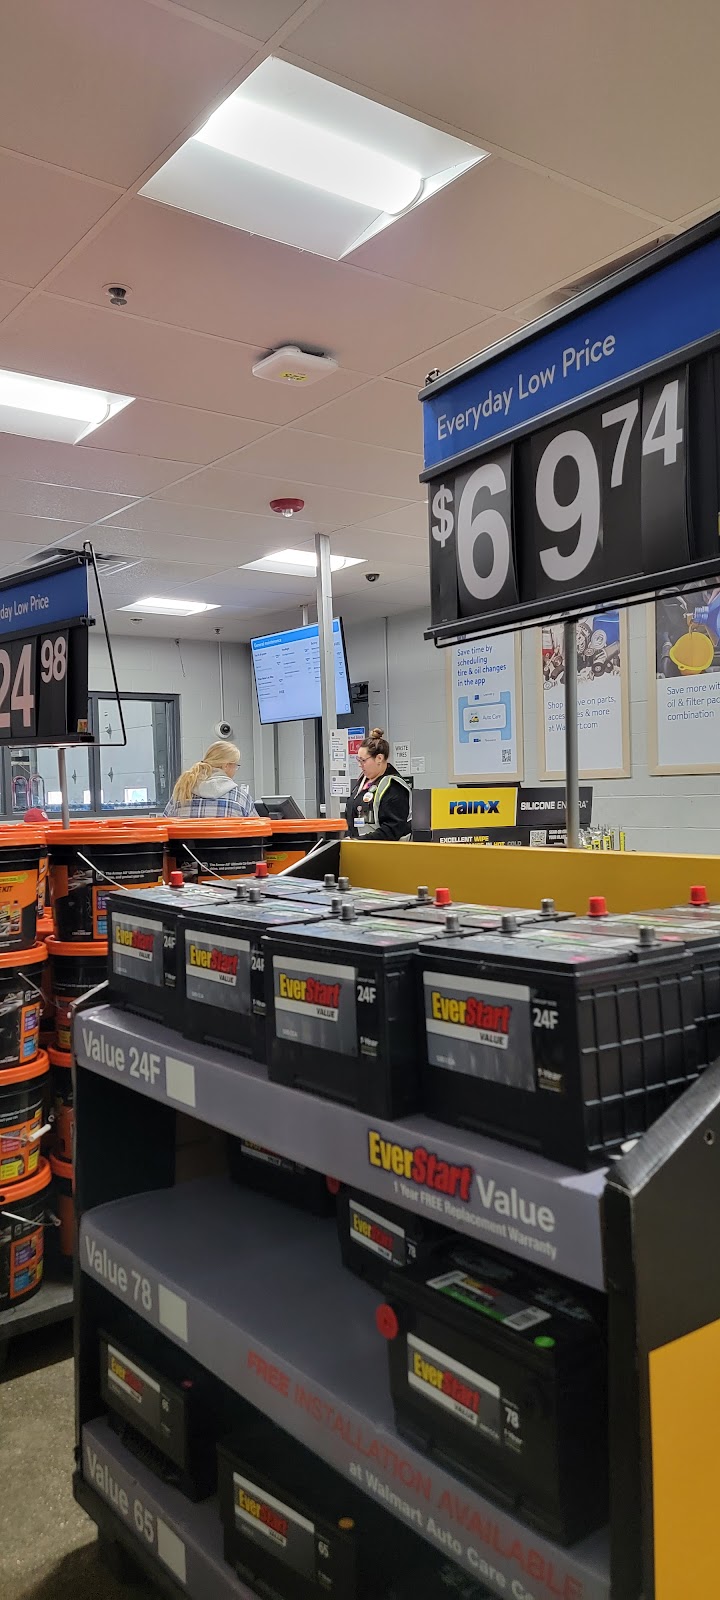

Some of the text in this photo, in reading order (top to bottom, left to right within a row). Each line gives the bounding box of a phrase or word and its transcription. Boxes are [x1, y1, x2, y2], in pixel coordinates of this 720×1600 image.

[437, 333, 616, 441] Everyday Low Price
[0, 595, 49, 622] day Low Price
[41, 636, 66, 683] 98
[471, 646, 484, 654] time
[485, 644, 493, 653] by
[457, 656, 488, 667] scheduling
[457, 664, 507, 676] tire & oil changes
[457, 677, 486, 687] in the app
[666, 686, 685, 695] Save
[686, 685, 707, 694] more
[547, 701, 564, 710] Shop
[584, 708, 591, 717] &
[591, 708, 610, 717] more
[666, 698, 676, 708] oil
[677, 698, 685, 707] &
[686, 697, 705, 707] filter
[667, 709, 715, 721] combination
[520, 801, 556, 811] SILICONE
[439, 836, 473, 844] EXCELLENT
[115, 925, 154, 953] EverStart
[163, 935, 176, 949] 24F
[190, 944, 239, 976] EverStart
[219, 974, 234, 983] VALUE
[279, 973, 342, 1009] EverStart
[356, 985, 377, 1004] 24F
[316, 1007, 335, 1019] VALUE
[431, 991, 512, 1034] EverStart
[532, 1007, 559, 1030] 24F
[479, 1032, 505, 1046] VALUE
[82, 1028, 161, 1085] Value 24F
[367, 1129, 556, 1233] EverStart Value
[353, 1212, 394, 1253] EverStart
[393, 1181, 557, 1261] 1 Year FREE Replacement Warranty
[407, 1243, 417, 1259] 78
[84, 1235, 154, 1312] Value 78
[413, 1351, 480, 1415] EverStart
[454, 1403, 475, 1420] VALUE
[505, 1406, 520, 1430] 78
[247, 1350, 584, 1600] FREE INSTALLATION AVAILABLE
[86, 1445, 155, 1545] Value 65
[238, 1487, 289, 1539] EverStart
[349, 1461, 363, 1479] at
[365, 1470, 423, 1525] Walmart
[425, 1512, 463, 1556] Auto
[466, 1546, 507, 1591] Care
